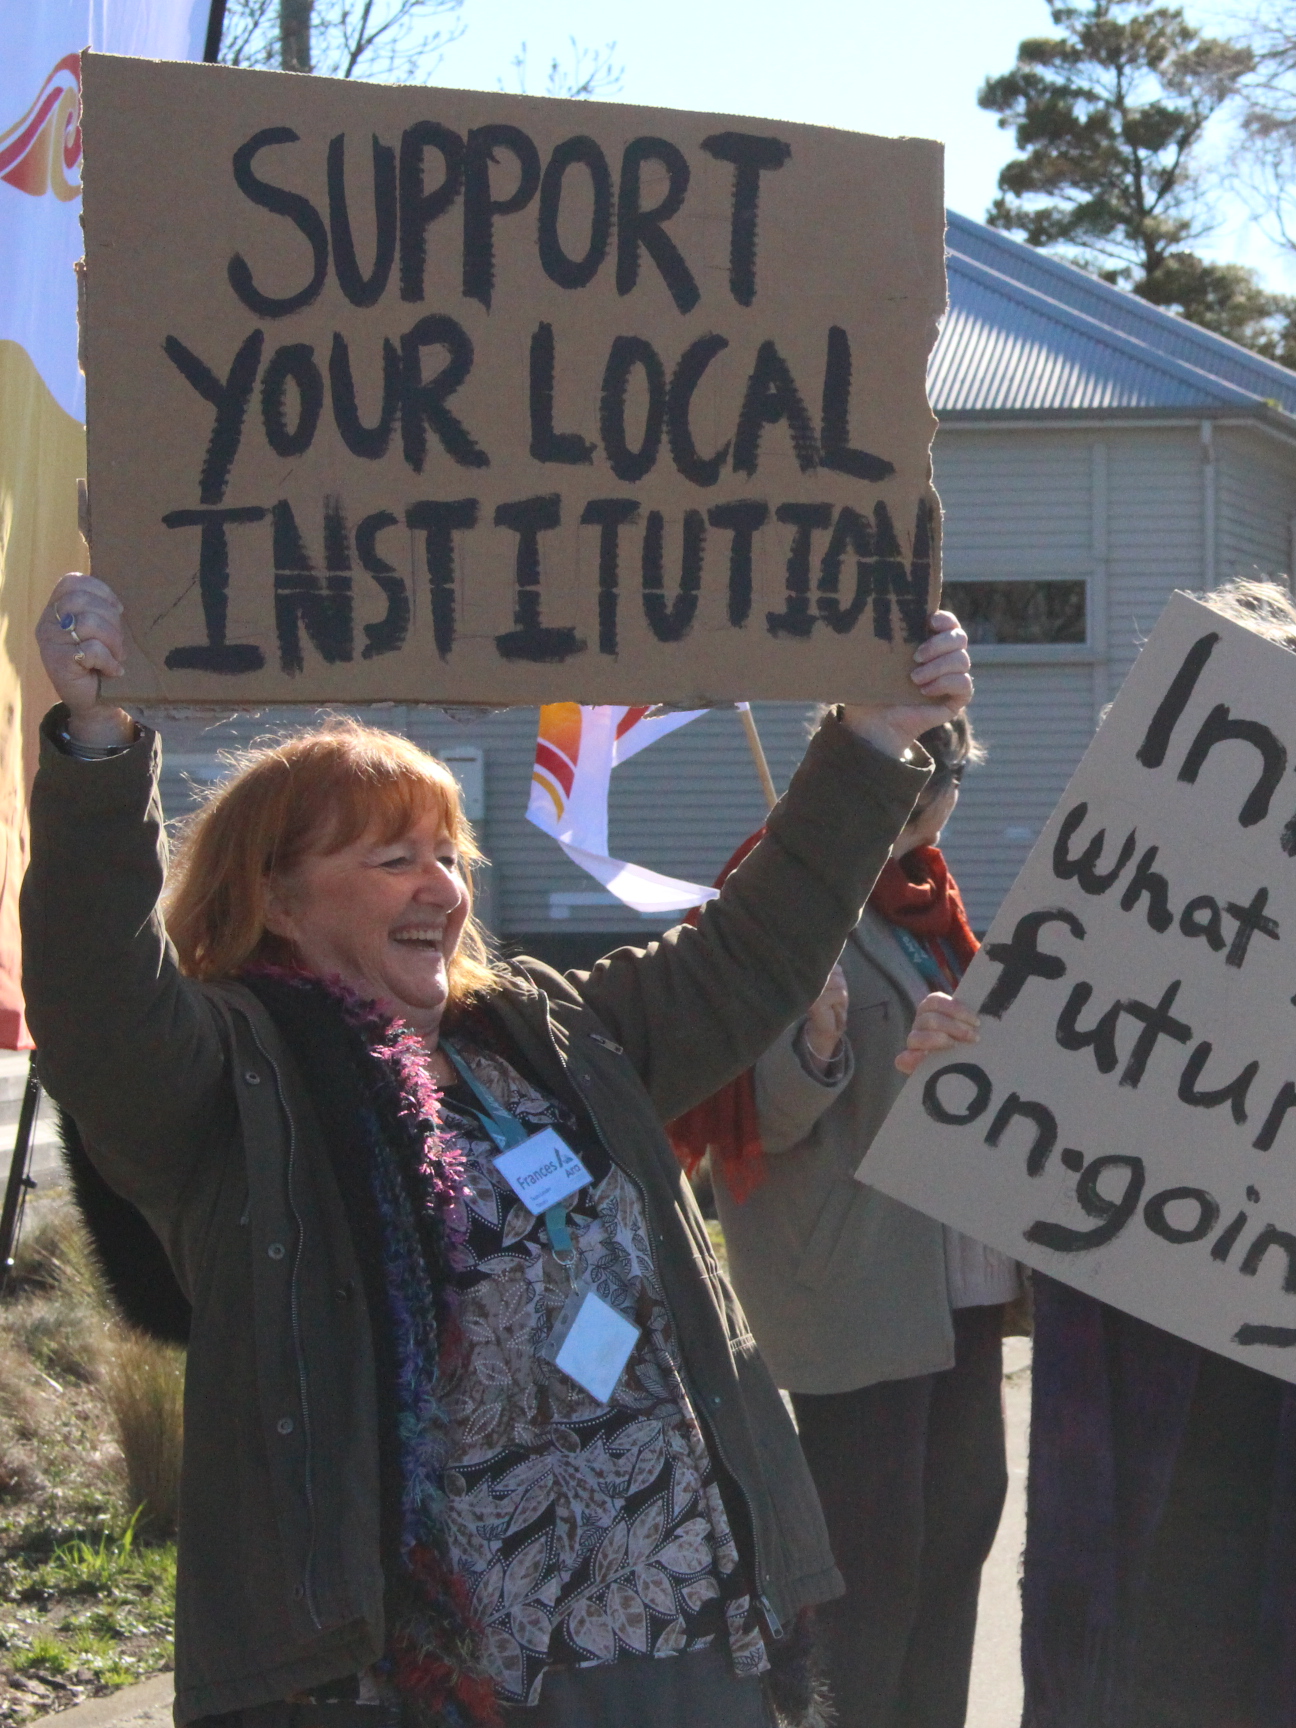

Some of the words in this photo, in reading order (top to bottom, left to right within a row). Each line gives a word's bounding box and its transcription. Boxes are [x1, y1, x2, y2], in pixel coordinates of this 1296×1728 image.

[227, 120, 792, 318] SUPPORT
[162, 315, 491, 504] YOUR
[530, 321, 896, 487] LOCAL
[162, 492, 936, 676] INSTITUTION
[1053, 801, 1279, 968] What
[516, 1160, 558, 1190] Frances
